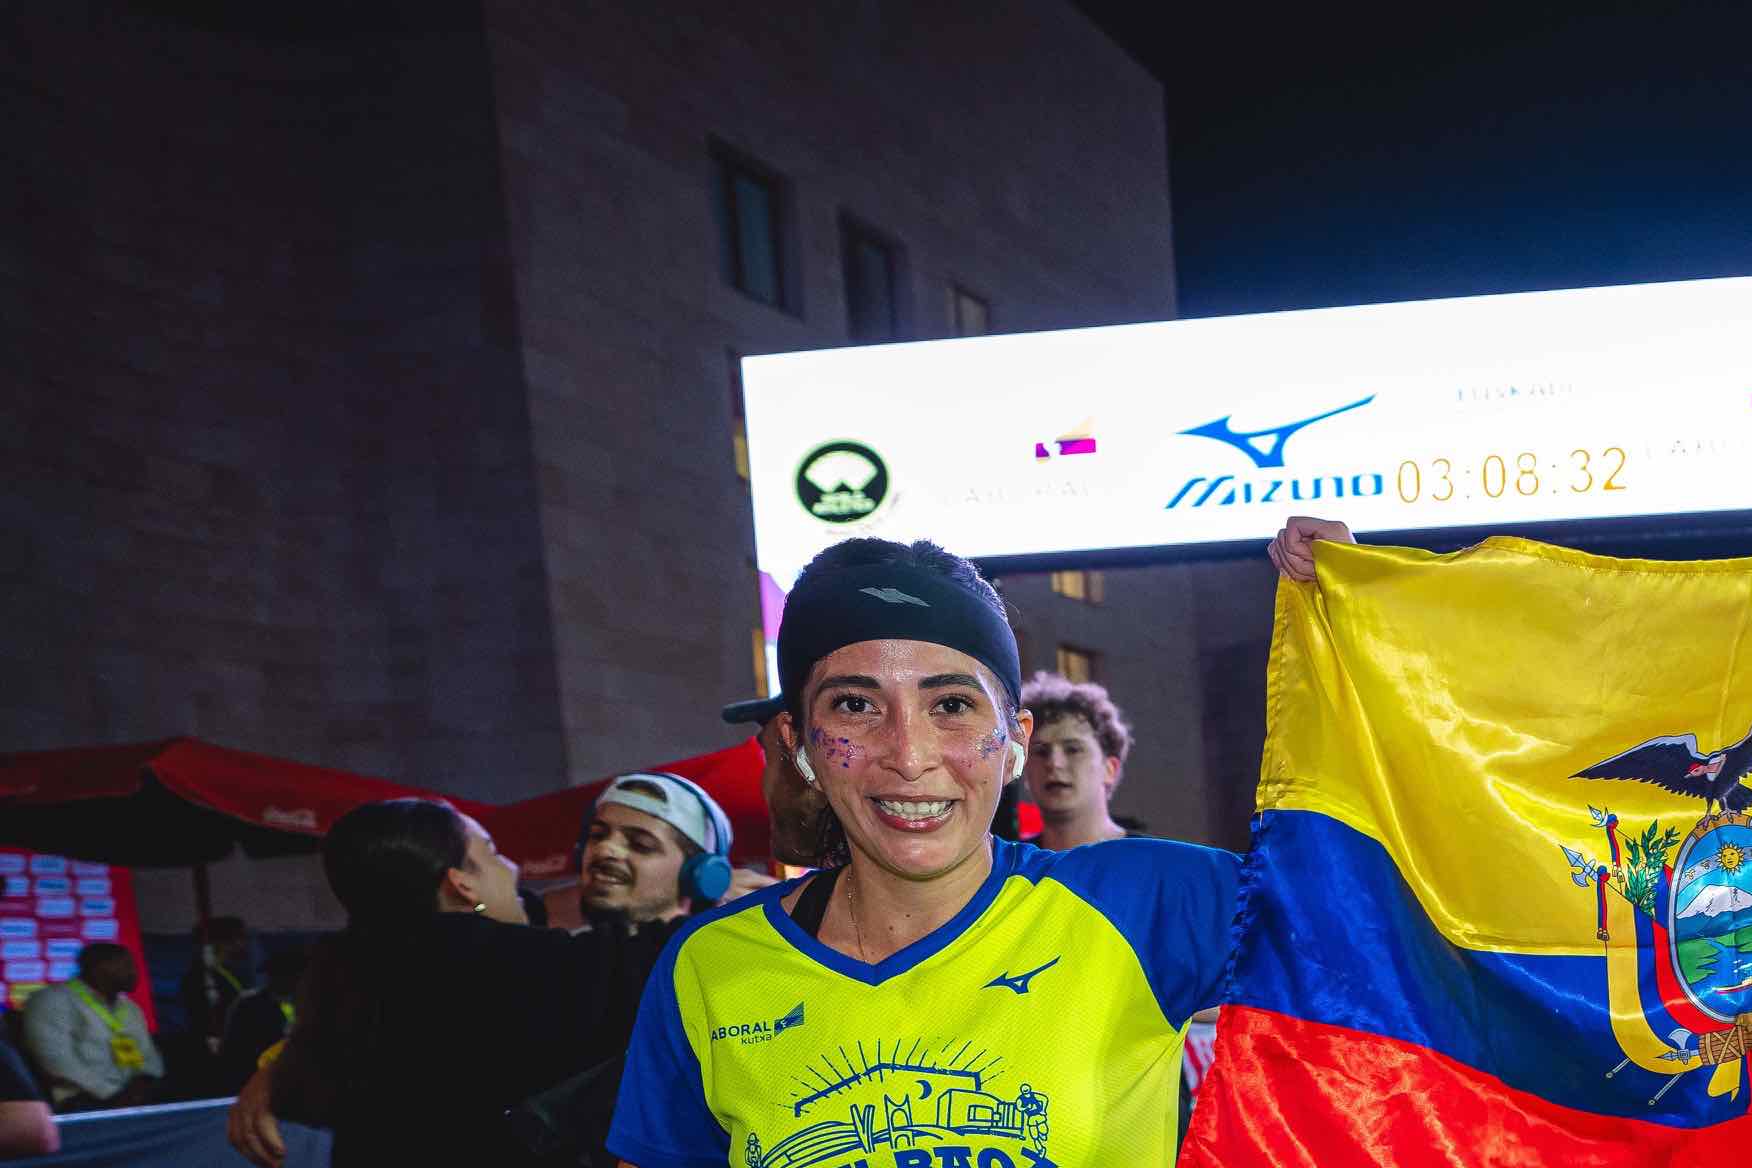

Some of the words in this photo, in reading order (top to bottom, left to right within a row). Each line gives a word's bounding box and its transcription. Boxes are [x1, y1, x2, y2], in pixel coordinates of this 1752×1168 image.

[1397, 445, 1630, 504] 03:08:32
[711, 1020, 772, 1041] ABORAL
[741, 1032, 773, 1046] kutxa
